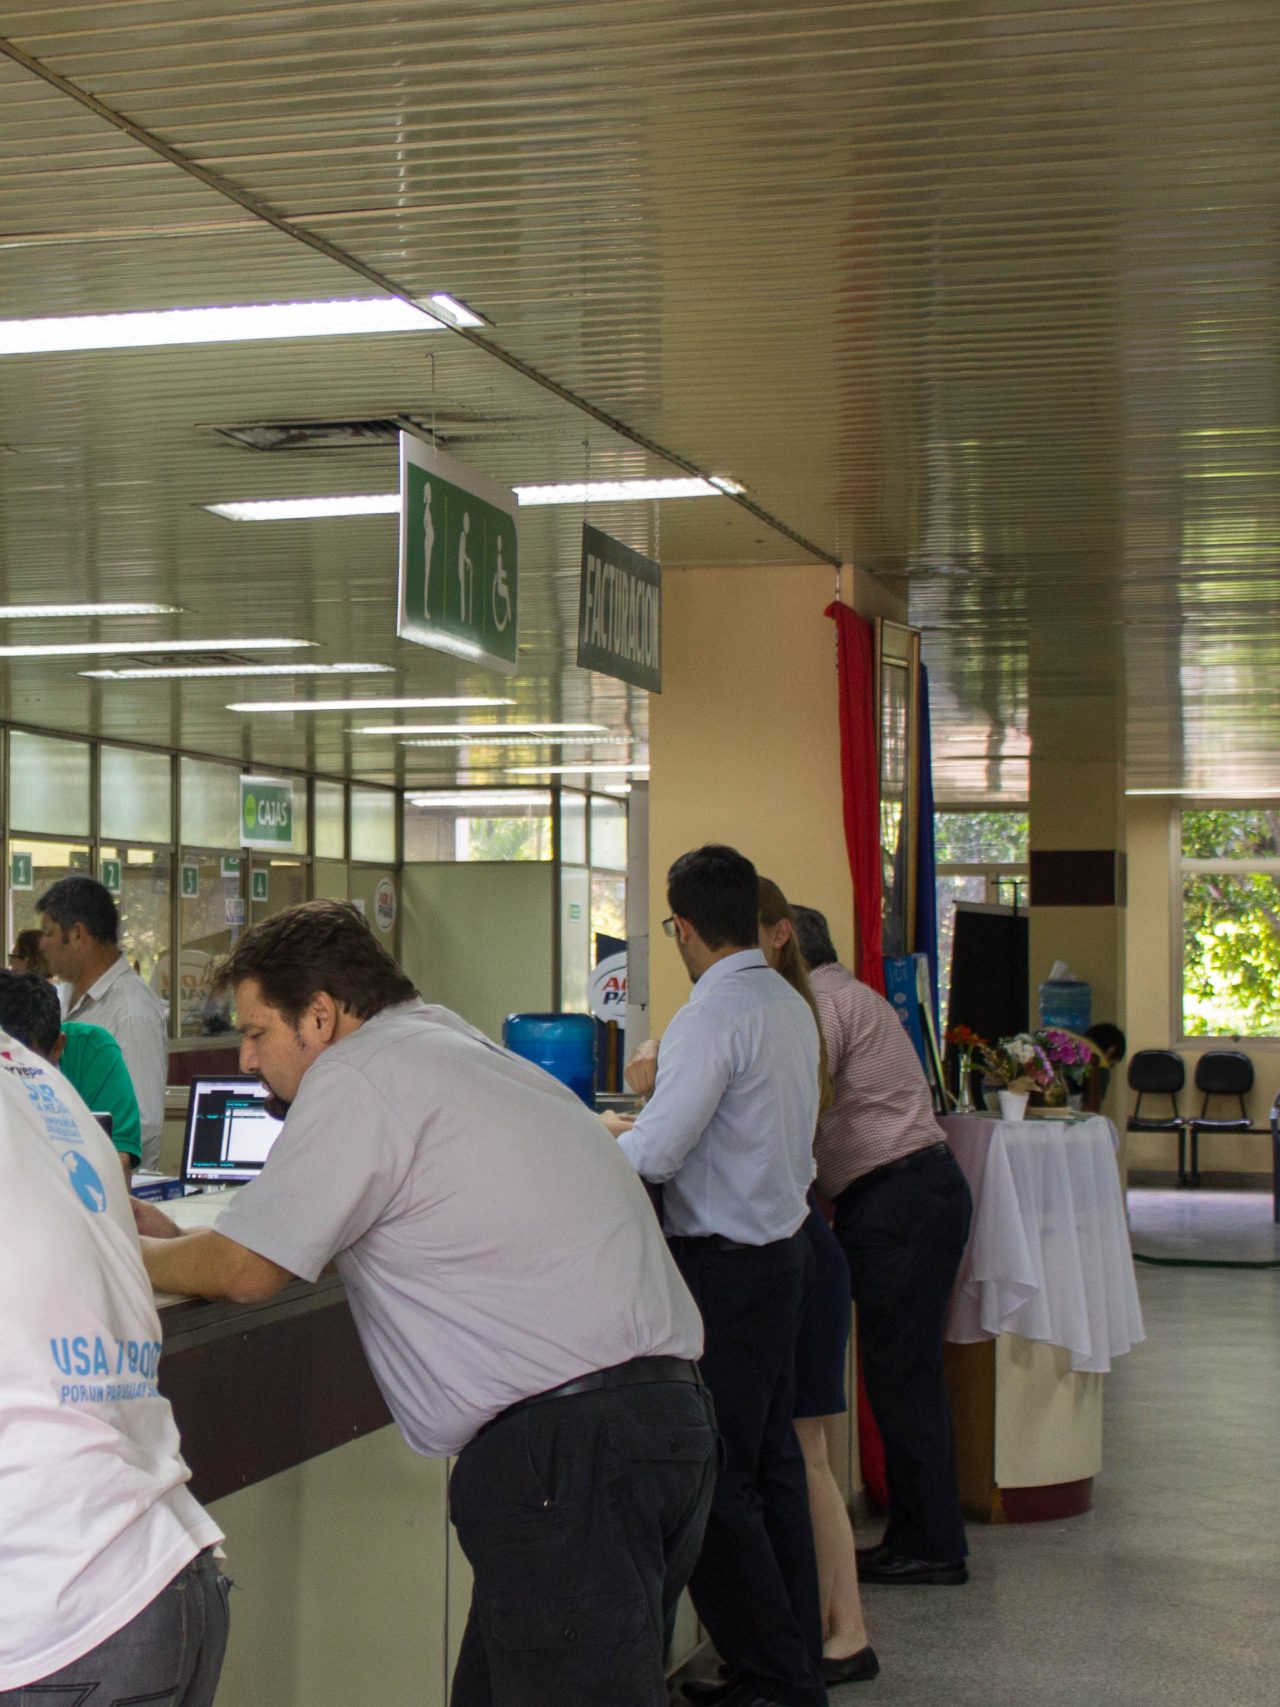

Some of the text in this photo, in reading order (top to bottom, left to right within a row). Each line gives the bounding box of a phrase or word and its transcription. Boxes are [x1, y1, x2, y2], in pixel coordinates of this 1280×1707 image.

[584, 554, 659, 670] FACTURACION
[257, 800, 288, 827] CAJAS
[18, 859, 25, 882] 1
[108, 865, 114, 887] 2
[187, 870, 193, 893] 3
[257, 876, 264, 897] 4
[50, 1336, 110, 1376] USA
[61, 1384, 88, 1404] POR
[89, 1384, 104, 1402] UN
